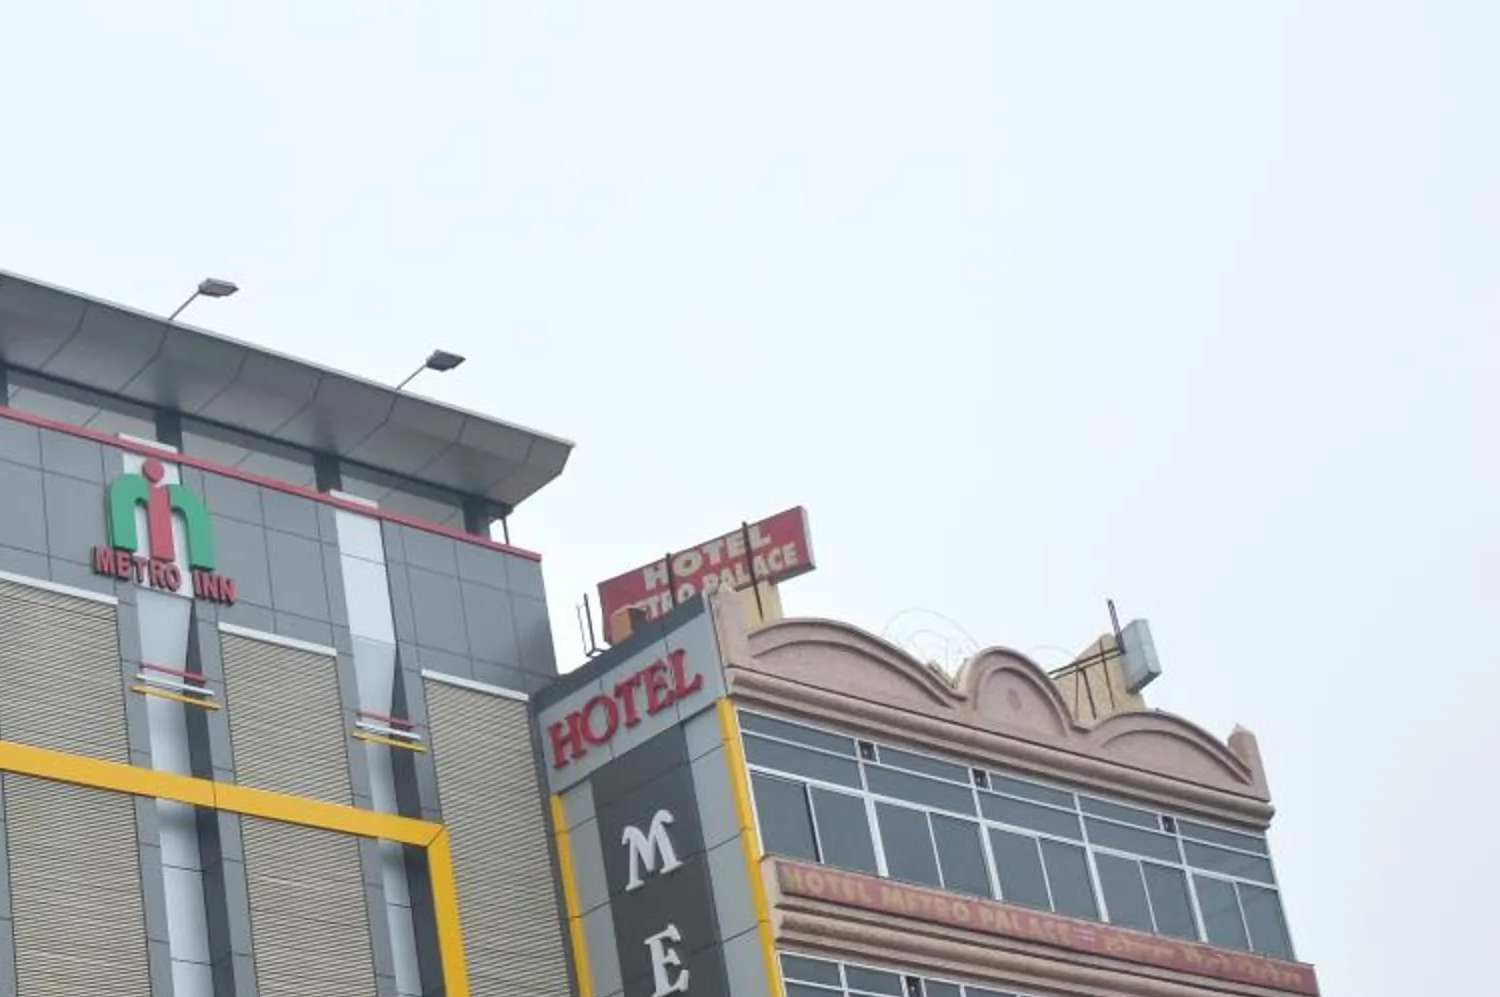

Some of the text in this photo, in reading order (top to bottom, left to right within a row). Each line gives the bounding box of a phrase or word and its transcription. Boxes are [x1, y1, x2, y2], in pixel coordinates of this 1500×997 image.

[93, 547, 237, 605] METRO INN
[643, 525, 772, 591] HOTEL
[703, 542, 798, 597] PALACE
[547, 648, 704, 769] HOTEL
